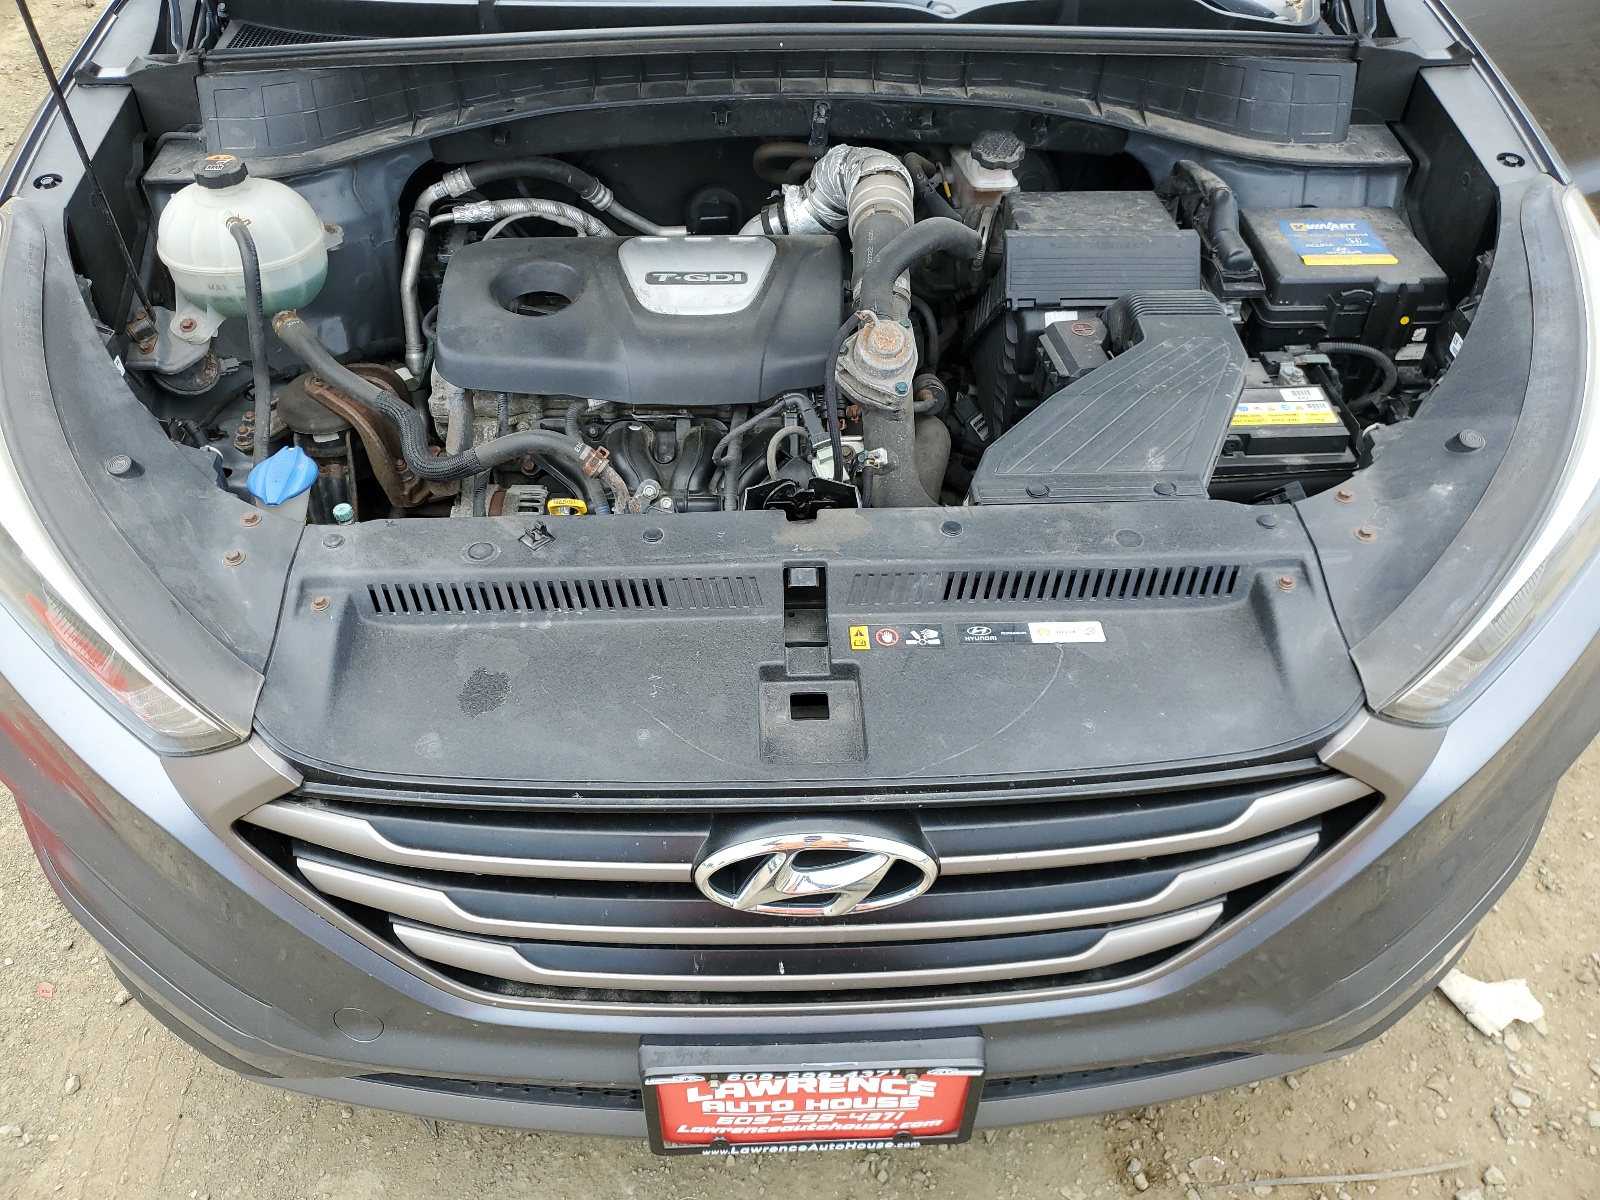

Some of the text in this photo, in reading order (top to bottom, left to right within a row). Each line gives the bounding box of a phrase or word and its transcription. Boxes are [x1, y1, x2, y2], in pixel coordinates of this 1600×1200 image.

[686, 1077, 937, 1103] LAWRENCE
[701, 1096, 921, 1113] AUTO HOUSE
[716, 1111, 906, 1125] 609-599-4371
[676, 1119, 944, 1134] Lawrenceautohouse.com
[702, 1141, 921, 1156] www.LawrenceAutoHouse.com
